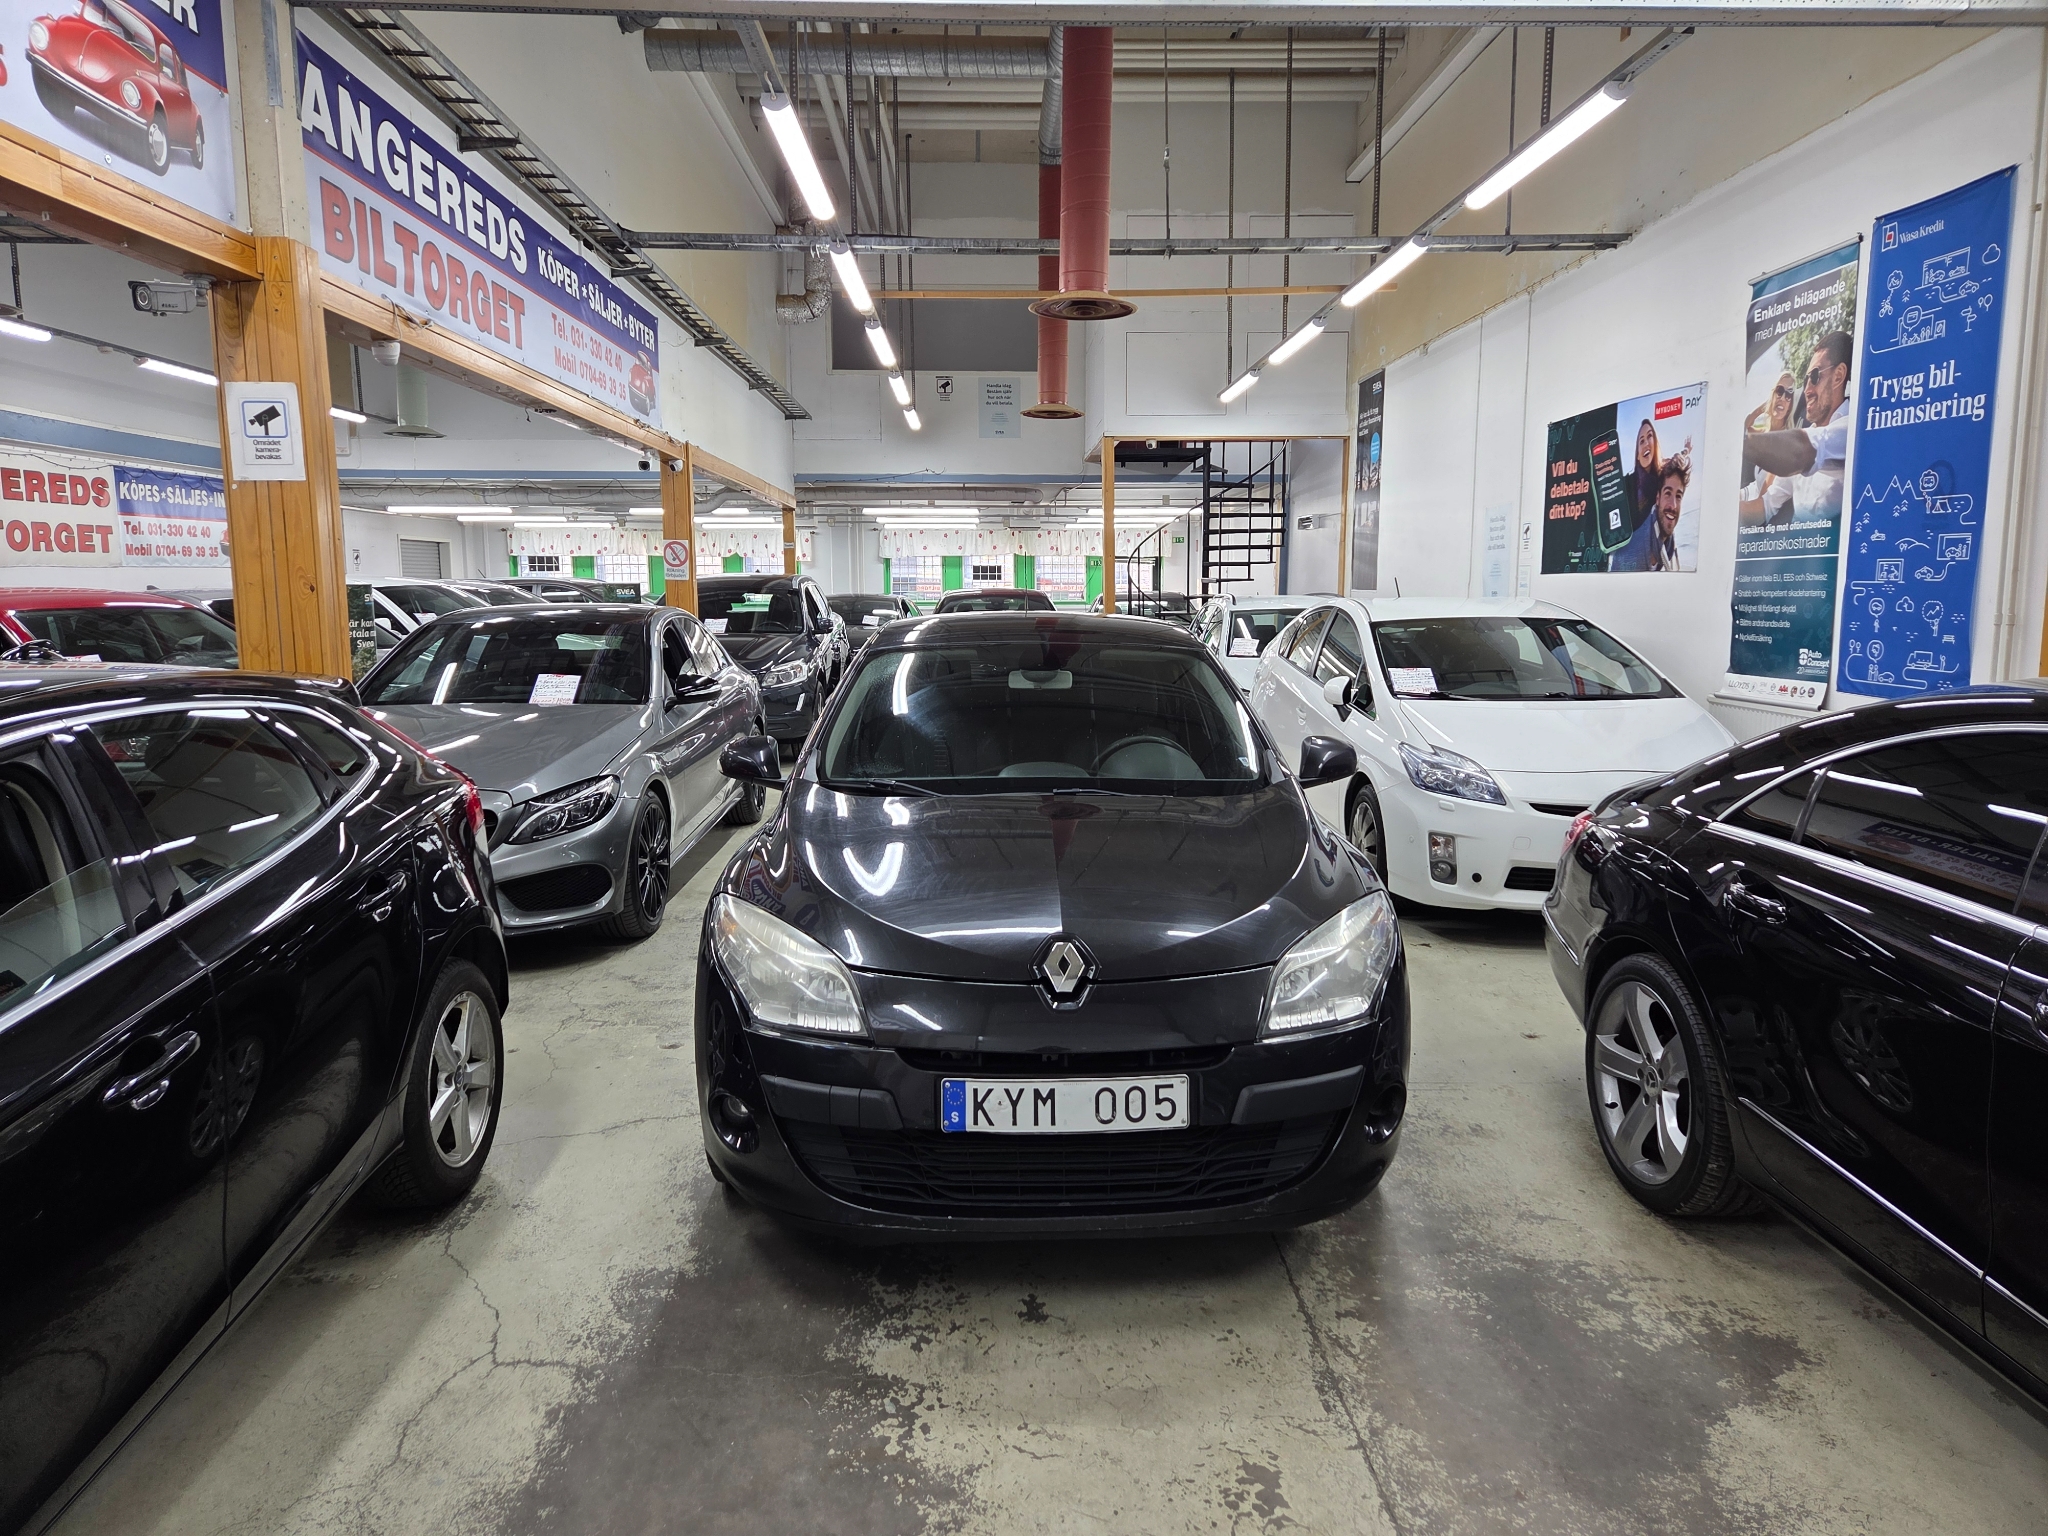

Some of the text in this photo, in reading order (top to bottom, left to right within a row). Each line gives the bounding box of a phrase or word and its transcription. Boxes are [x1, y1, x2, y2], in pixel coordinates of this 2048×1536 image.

[301, 61, 528, 275] ANGEREDS
[1900, 219, 1945, 244] Wasa Kredit
[320, 176, 526, 350] BILTORGET
[537, 246, 655, 352] KÖPER SÄLJER BYTER
[1753, 280, 1846, 323] Enklare bilägande
[1755, 300, 1843, 342] med AutoConcept
[551, 312, 568, 342] Tel.
[590, 335, 602, 362] 330
[604, 346, 613, 368] 42
[615, 352, 623, 374] 40
[554, 346, 577, 376] Mobil
[608, 377, 617, 397] 39
[619, 381, 627, 401] 35
[1869, 360, 1962, 403] Trygg bil-
[1685, 395, 1702, 409] PAY
[1865, 392, 1987, 431] finansiering
[1552, 461, 1565, 477] Vill
[1566, 459, 1578, 475] du
[0, 467, 111, 508] EREDS
[119, 479, 161, 503] KÖPES
[167, 484, 209, 508] SÄLJES
[1550, 478, 1590, 499] delbetala
[1549, 500, 1587, 521] ditt köp?
[124, 521, 211, 539] Tel. 031-330 42 40
[1739, 519, 1832, 535] Försäkra dig mot oförutsedda
[125, 543, 219, 558] Mobil 0704-69 39 35
[1739, 534, 1831, 555] reparationskostnader
[1783, 573, 1795, 581] EES
[1795, 573, 1805, 581] och
[1805, 572, 1828, 581] Schweiz
[356, 639, 375, 648] Svea
[1808, 649, 1822, 659] Auto
[1806, 658, 1830, 668] Concept
[1727, 679, 1750, 690] LLOYDS
[972, 1083, 1177, 1127] KYM 005
[950, 1112, 960, 1123] S
